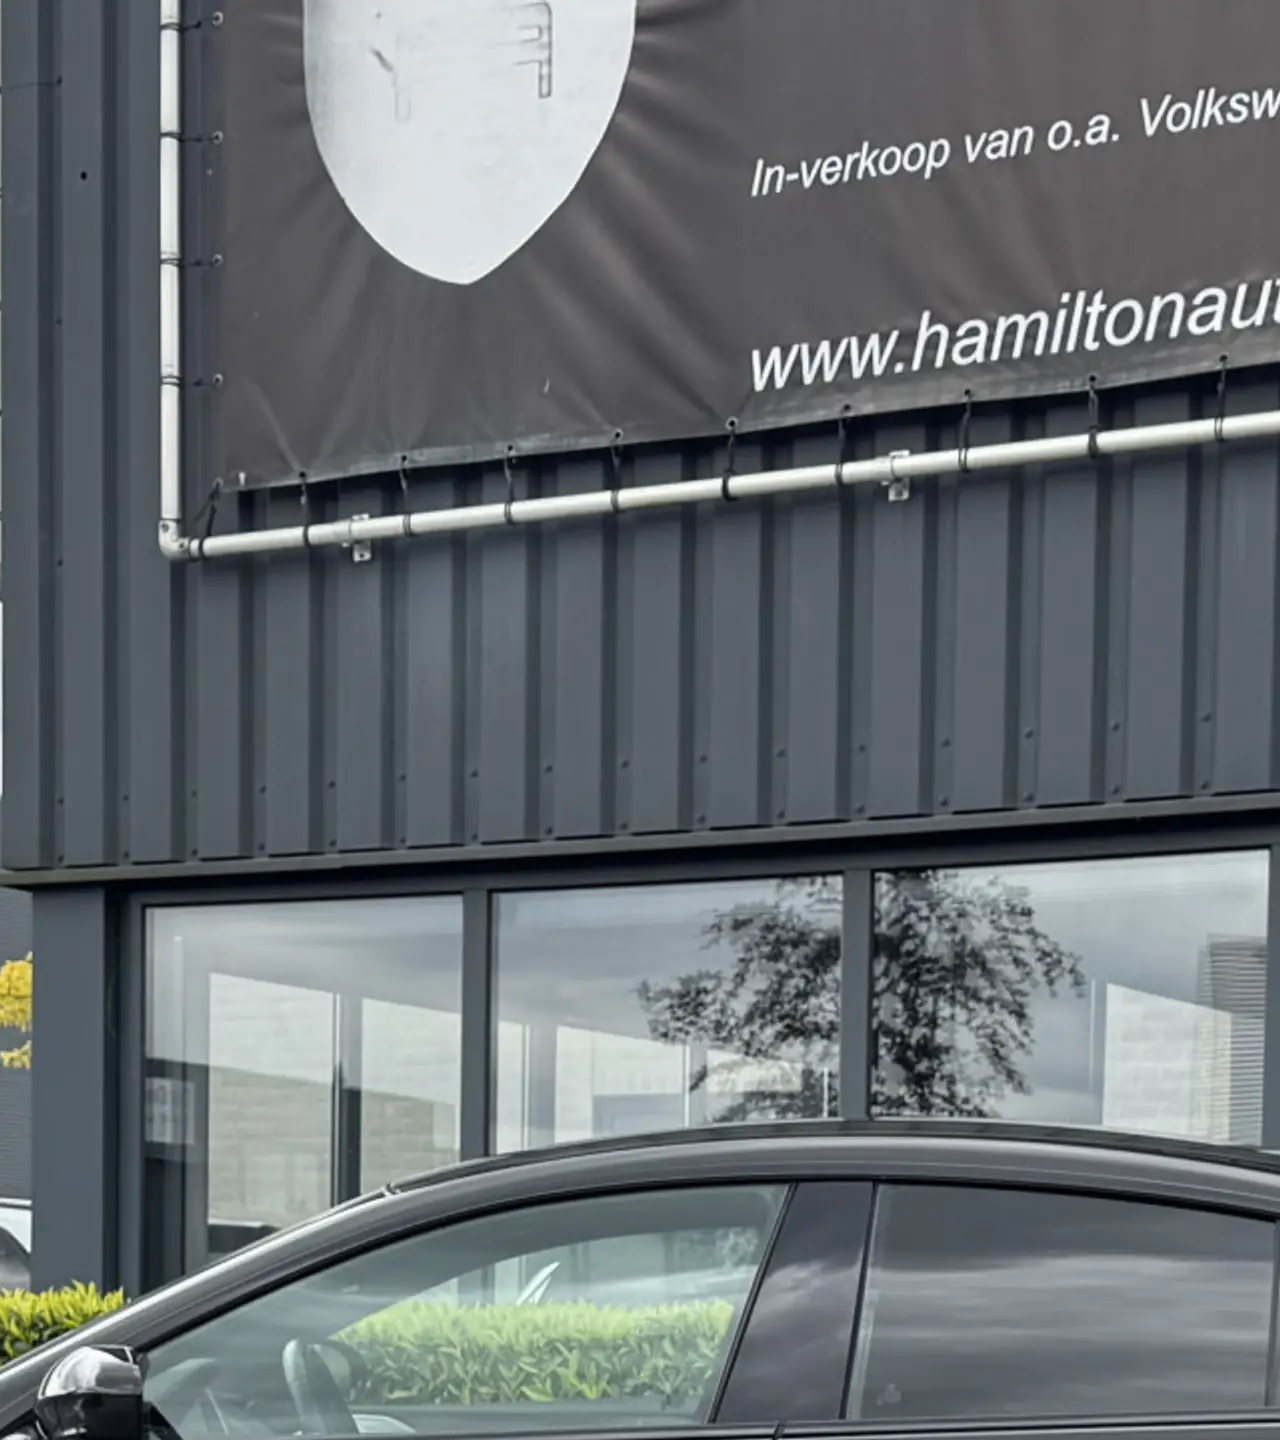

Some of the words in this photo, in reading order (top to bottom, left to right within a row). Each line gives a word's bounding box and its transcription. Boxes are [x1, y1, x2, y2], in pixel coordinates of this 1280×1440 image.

[751, 138, 951, 198] In-verkoop
[965, 125, 1034, 163] van
[1047, 114, 1120, 151] o.a.
